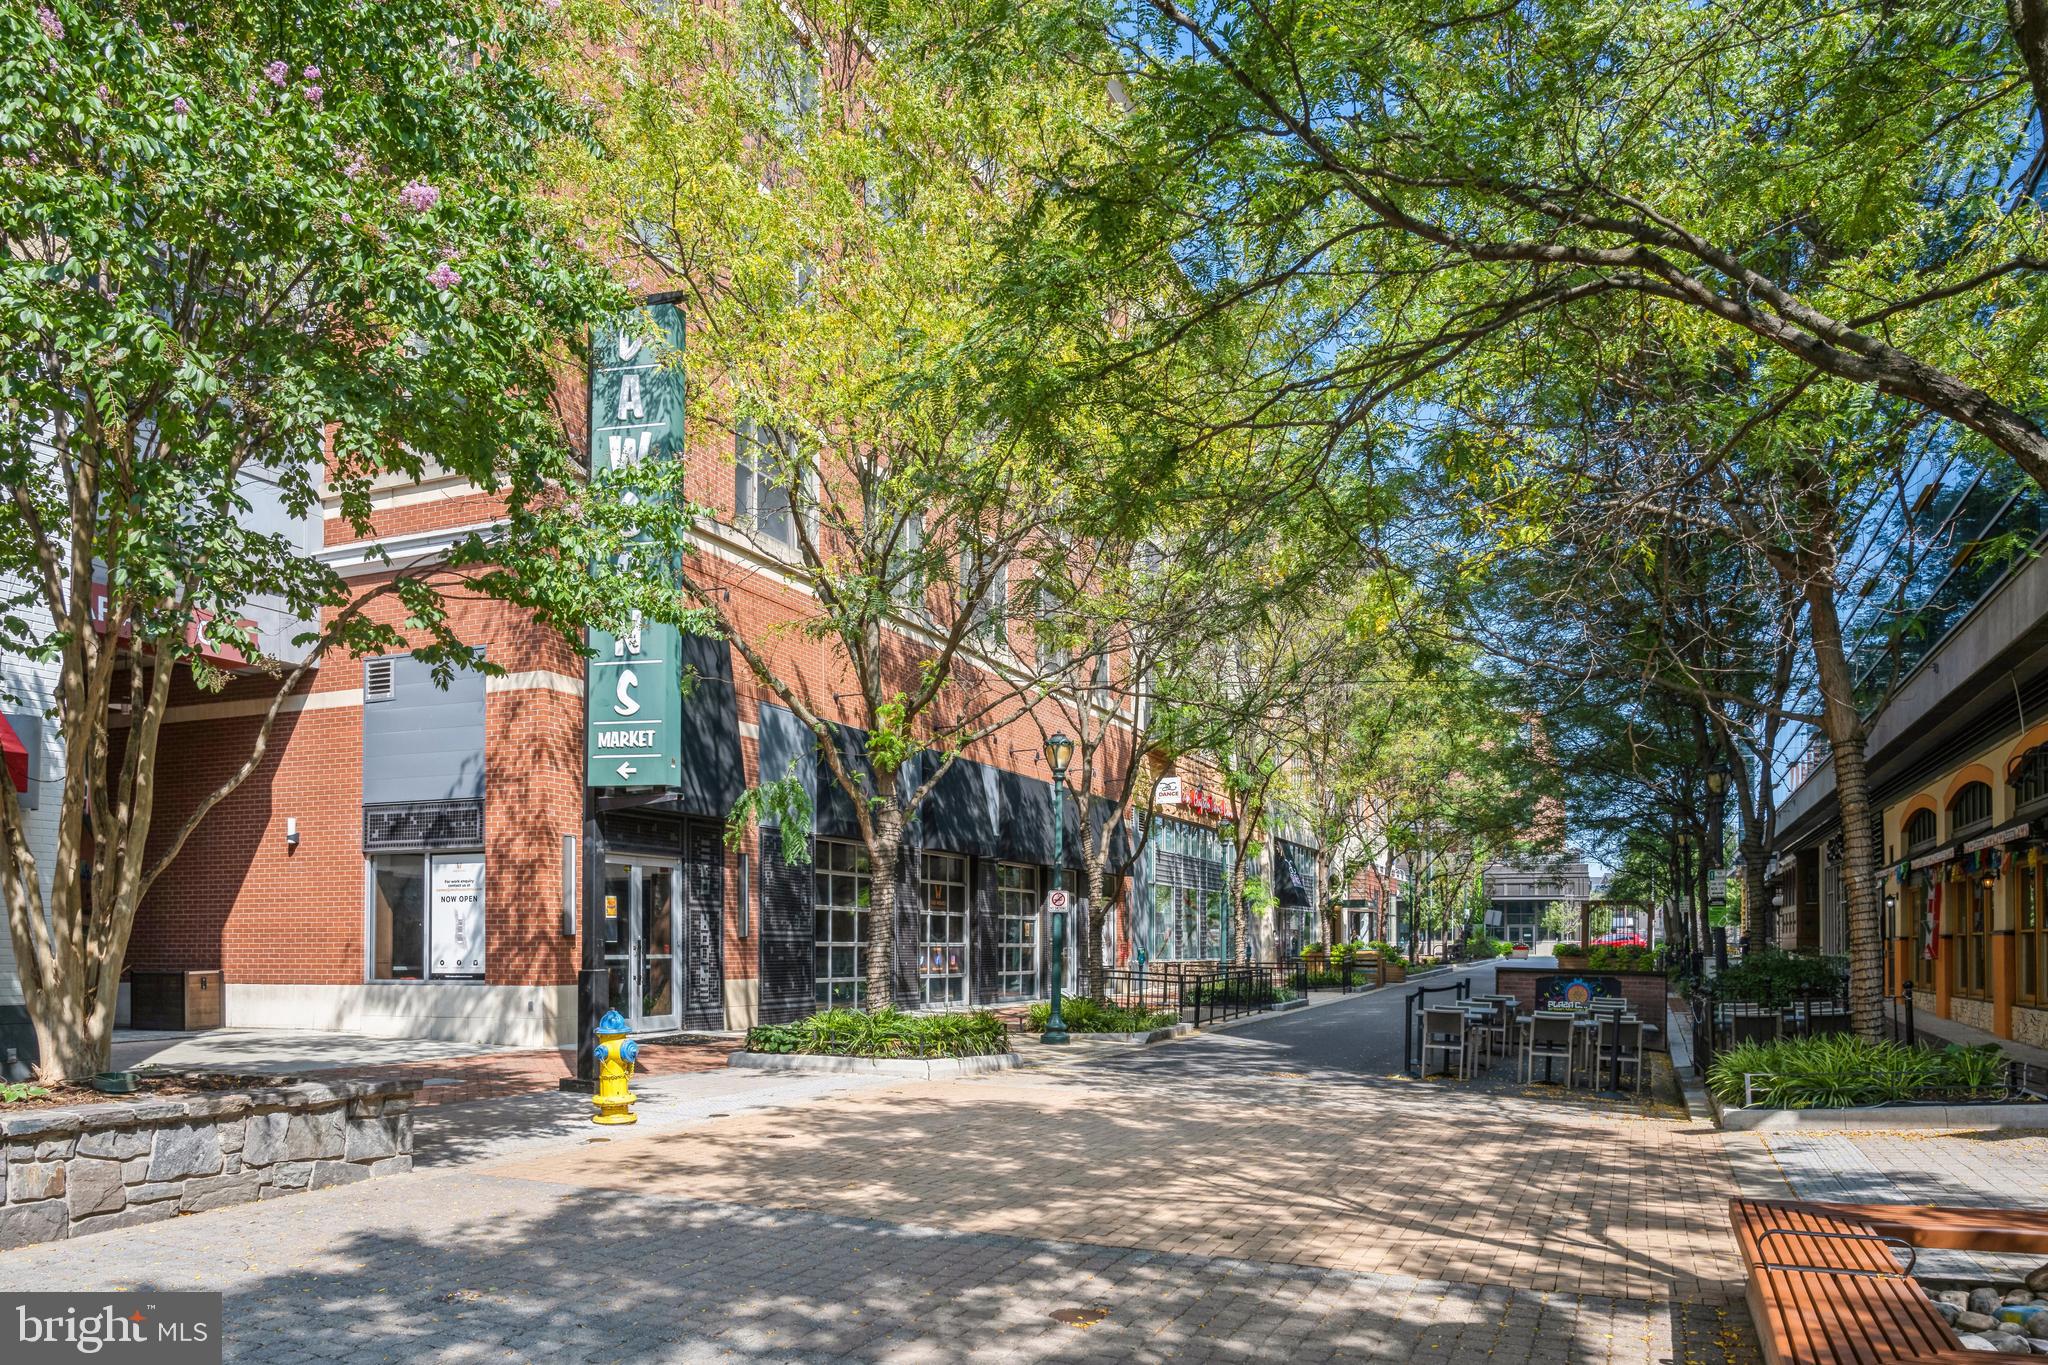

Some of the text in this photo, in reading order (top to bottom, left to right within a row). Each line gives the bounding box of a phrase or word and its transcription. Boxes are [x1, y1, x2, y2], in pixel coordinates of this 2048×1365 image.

[597, 729, 656, 749] MARKET
[1158, 790, 1179, 798] DANCE
[440, 895, 478, 903] NOW OPEN
